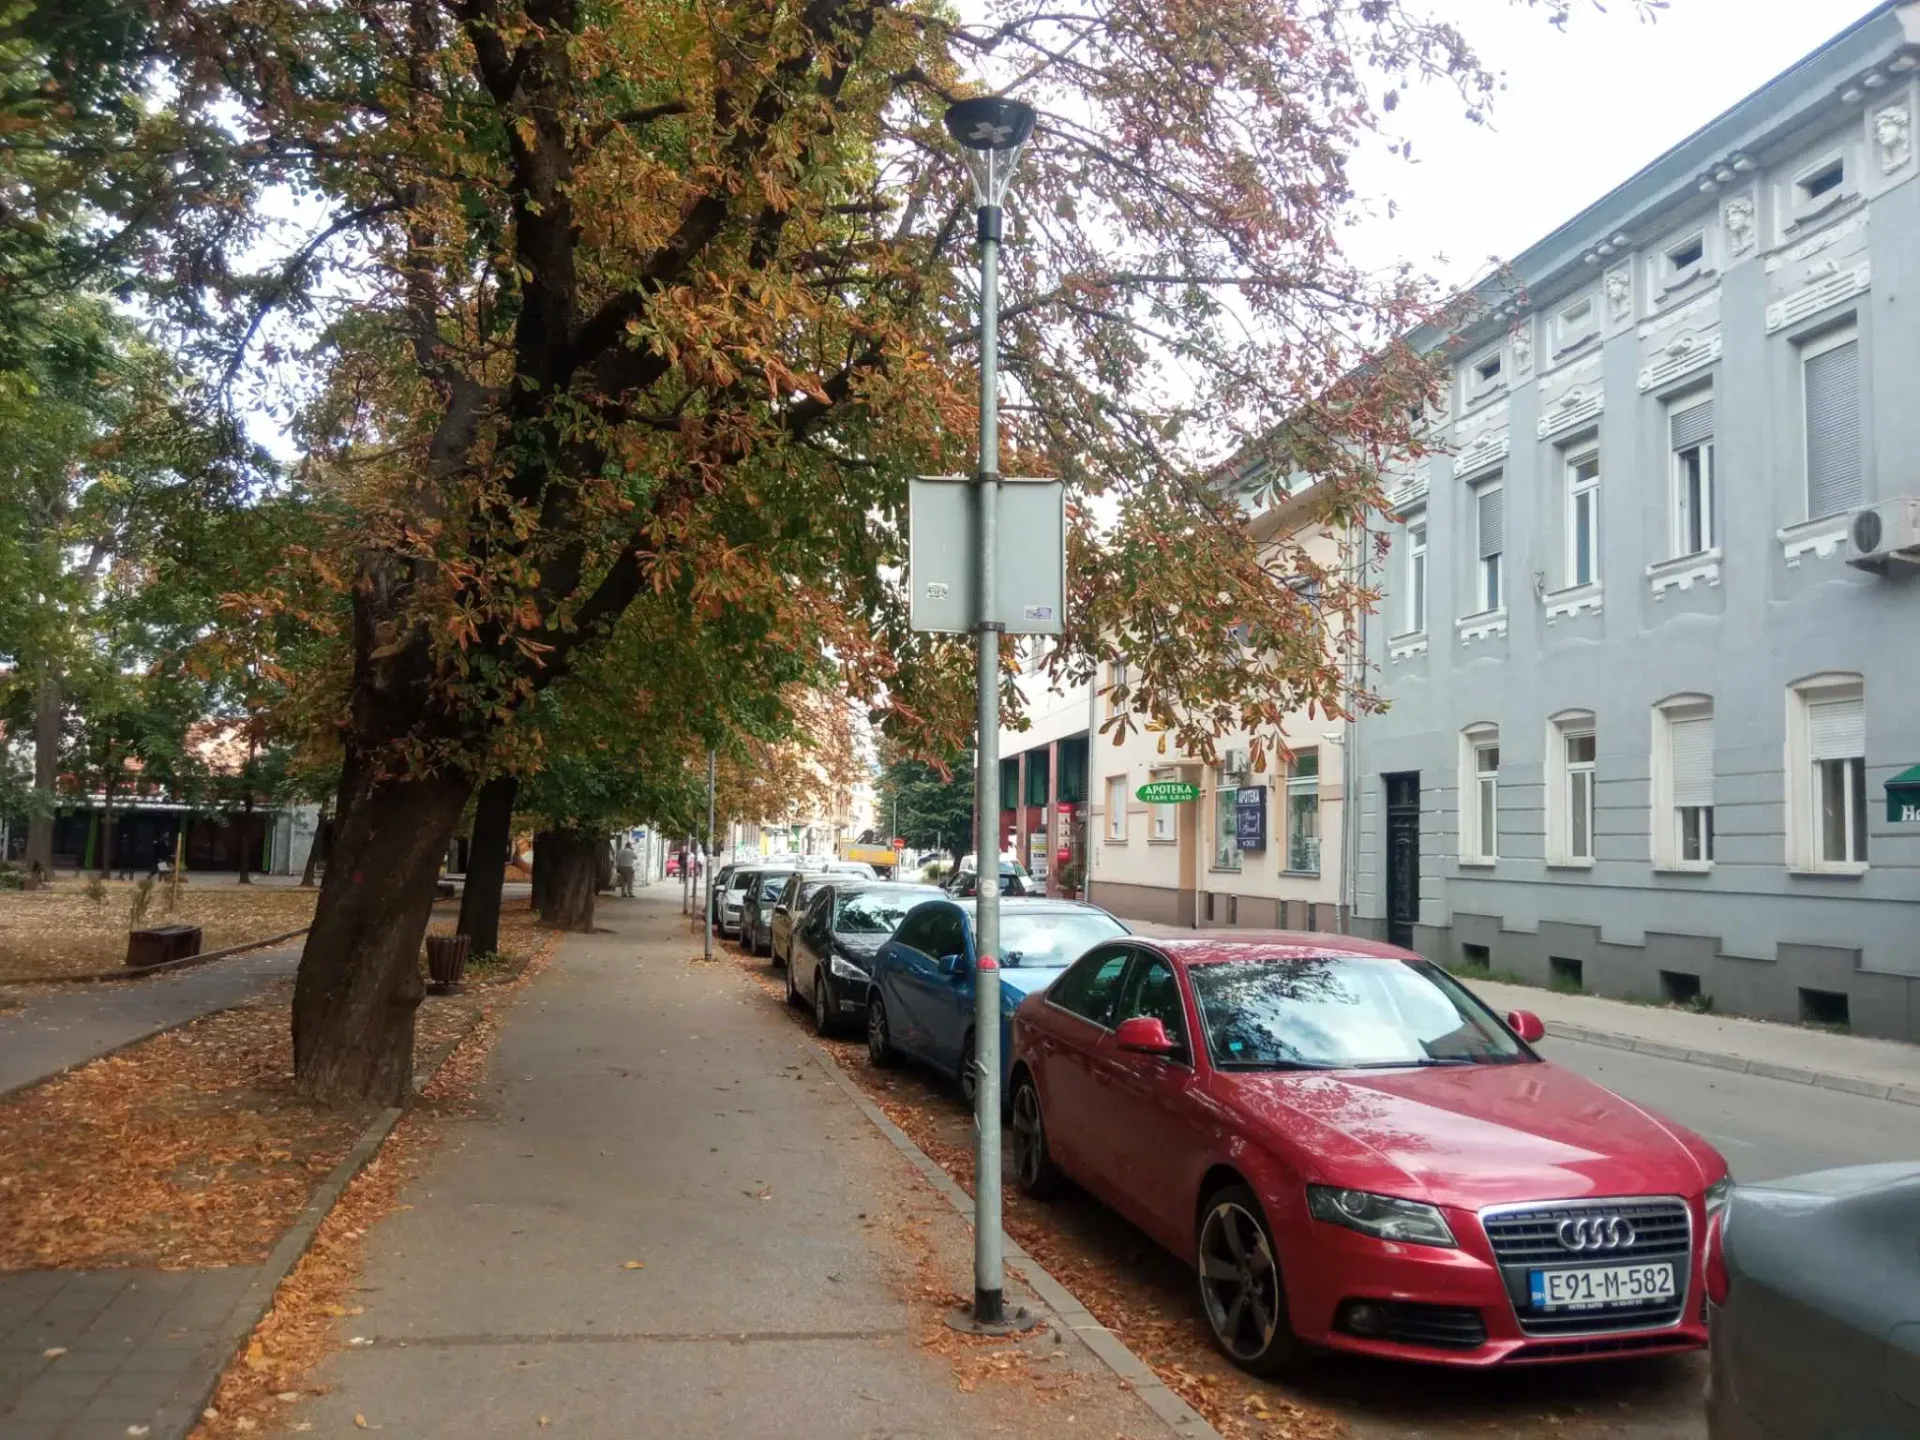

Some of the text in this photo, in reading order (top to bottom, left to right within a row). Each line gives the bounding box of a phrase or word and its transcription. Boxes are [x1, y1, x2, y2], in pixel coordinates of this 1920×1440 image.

[1145, 784, 1193, 795] APOTEKA
[1238, 789, 1260, 804] APOTEKA
[1548, 1267, 1672, 1301] E91-M-582
